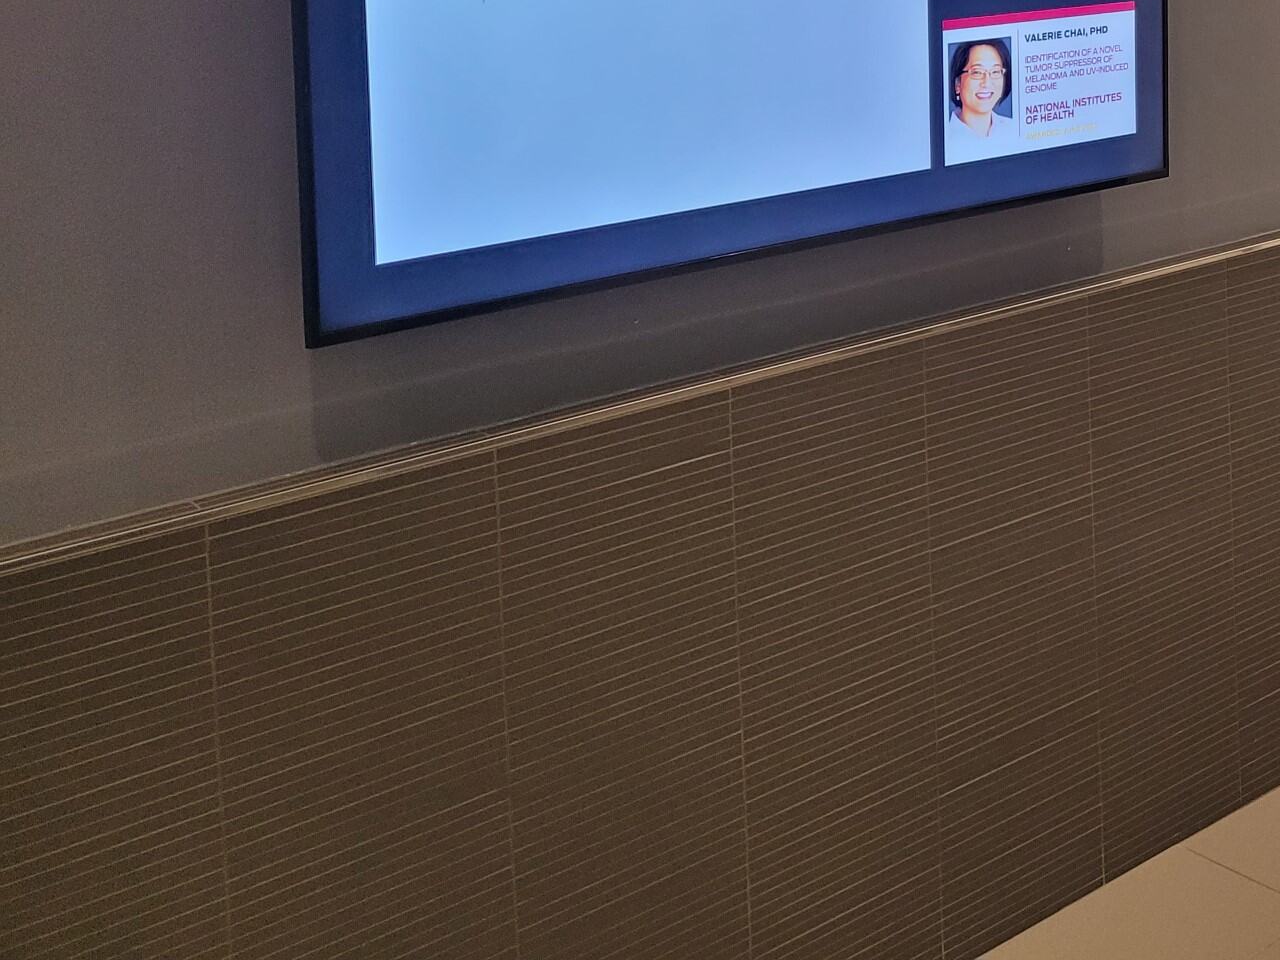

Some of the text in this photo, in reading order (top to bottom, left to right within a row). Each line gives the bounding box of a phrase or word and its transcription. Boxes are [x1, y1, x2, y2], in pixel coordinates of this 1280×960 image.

[1024, 25, 1108, 42] VALERIE CHAI, PHD
[1025, 44, 1123, 64] IDENTIFICATION OF A NOVEL
[1025, 55, 1113, 73] TUMOR SUPPRESSOR OF
[1025, 62, 1128, 84] MELANOMA AND UV-INDUCED
[1025, 82, 1057, 94] GENOME
[1025, 92, 1122, 115] NATIONAL INSTITUTES
[1026, 109, 1075, 125] OF HEALTH
